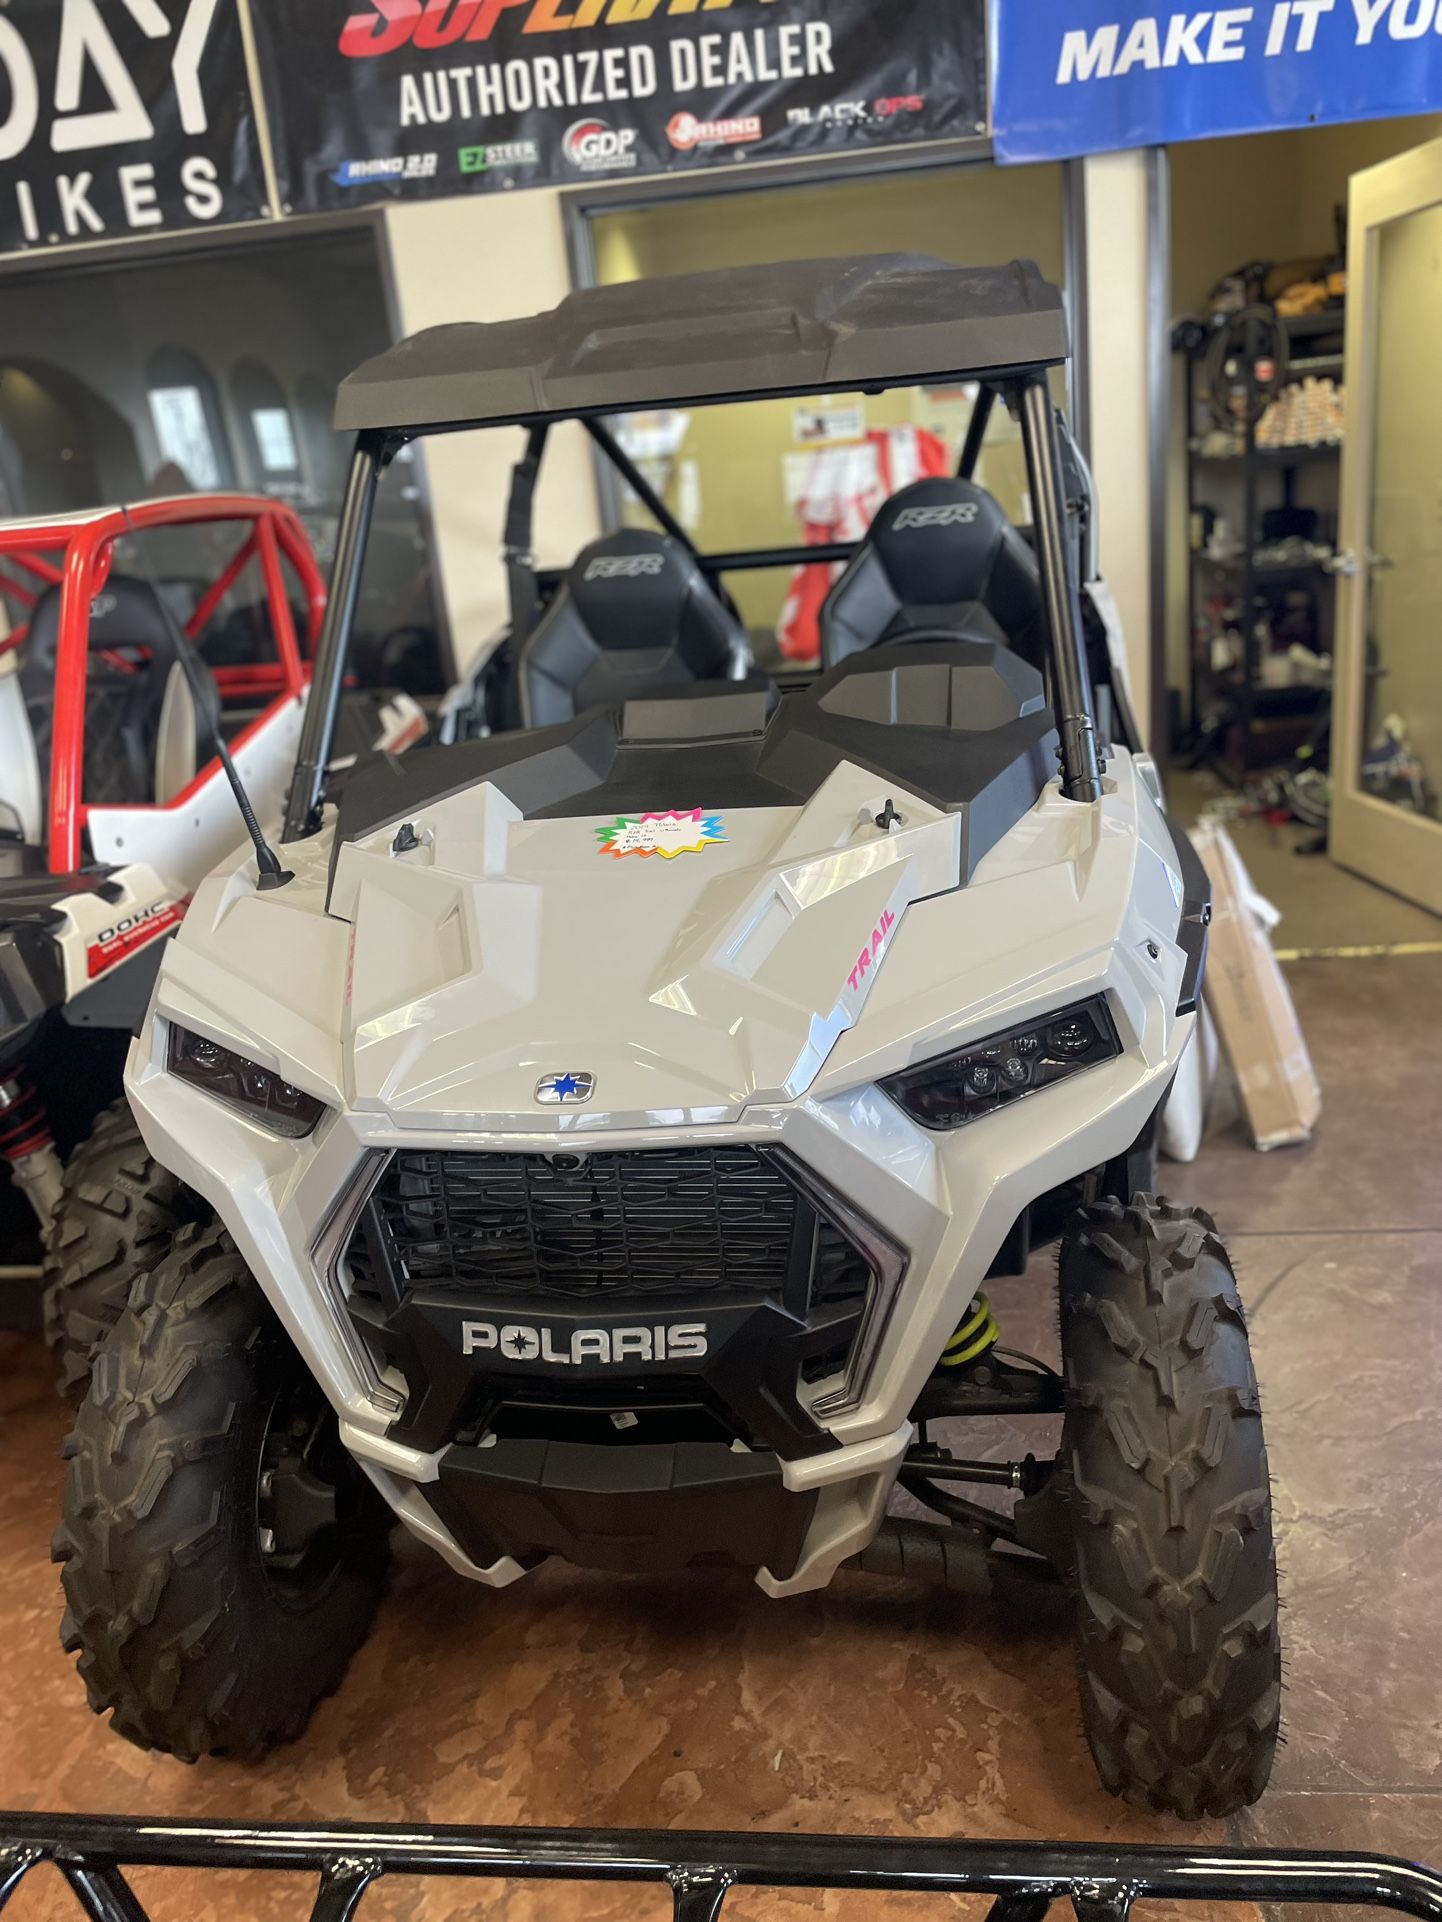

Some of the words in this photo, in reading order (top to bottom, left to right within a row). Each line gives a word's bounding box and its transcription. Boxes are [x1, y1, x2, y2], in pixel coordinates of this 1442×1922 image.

[1055, 7, 1254, 85] MAKE
[1264, 0, 1334, 57] IT
[1350, 0, 1442, 46] YO
[400, 45, 657, 127] AUTHORIZED
[669, 21, 835, 93] DEALER
[786, 100, 868, 126] BLACK
[874, 95, 924, 116] OPS
[580, 129, 636, 158] GDP
[98, 901, 166, 942] DOHC
[848, 909, 895, 992] TRAIL
[462, 1320, 708, 1365] POLARIS
